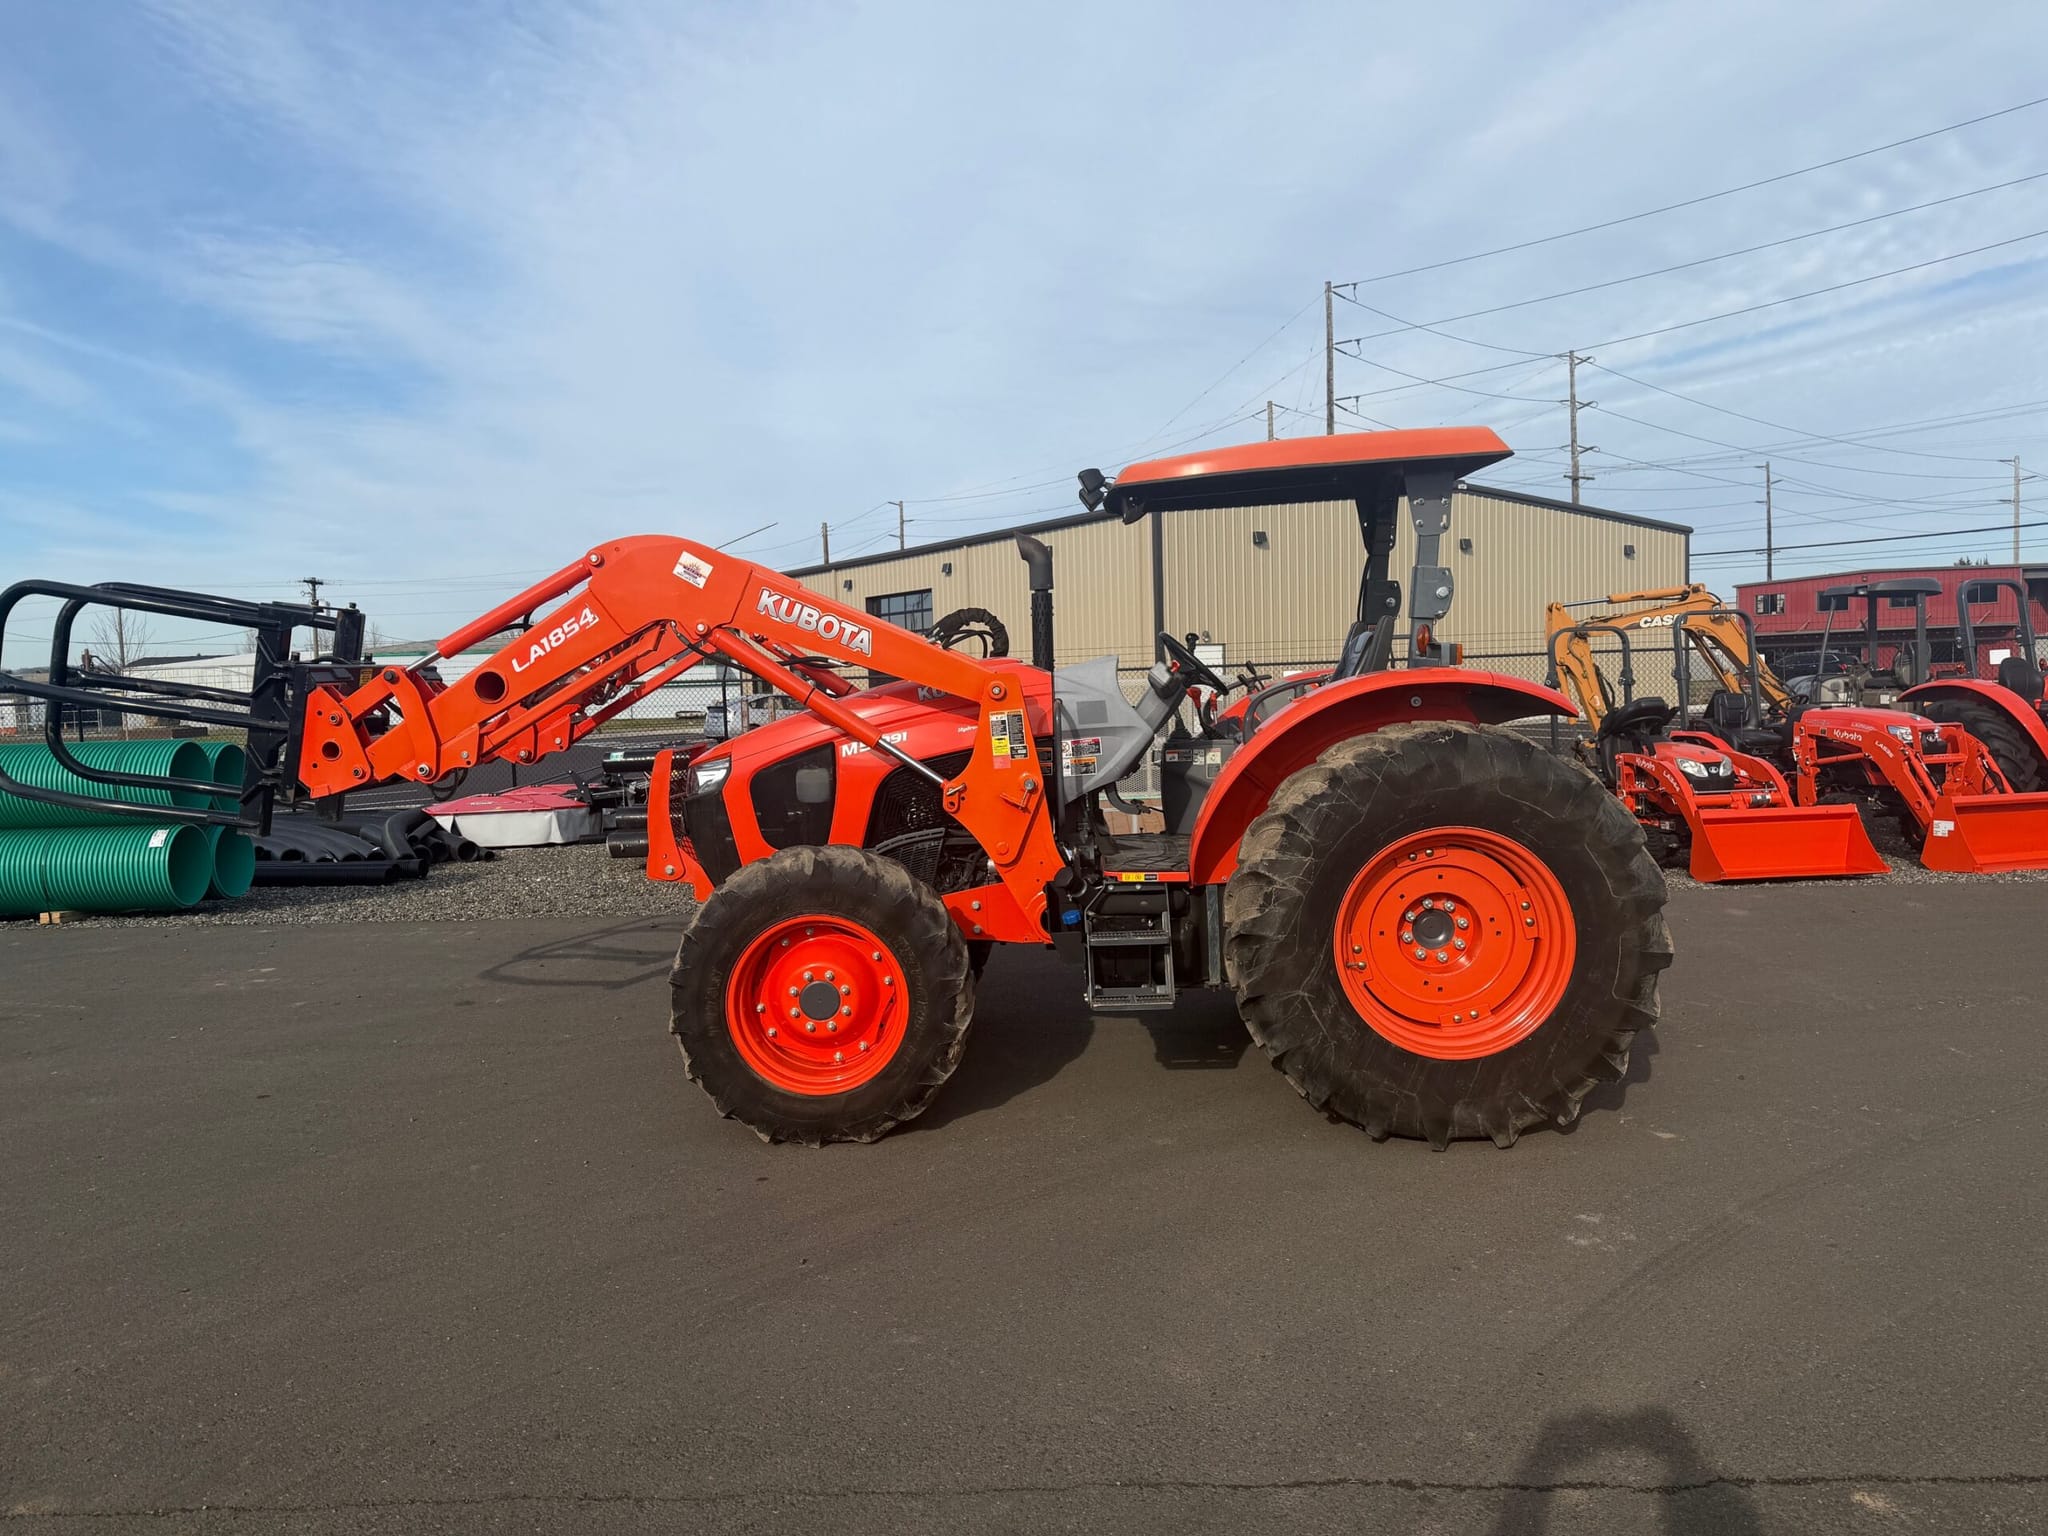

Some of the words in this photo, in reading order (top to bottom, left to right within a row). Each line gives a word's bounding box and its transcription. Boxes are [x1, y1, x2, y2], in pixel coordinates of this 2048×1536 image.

[511, 606, 599, 672] LA1854
[757, 587, 872, 656] KUBOTA
[1639, 613, 1680, 628] CAS
[1833, 728, 1863, 742] Kubota
